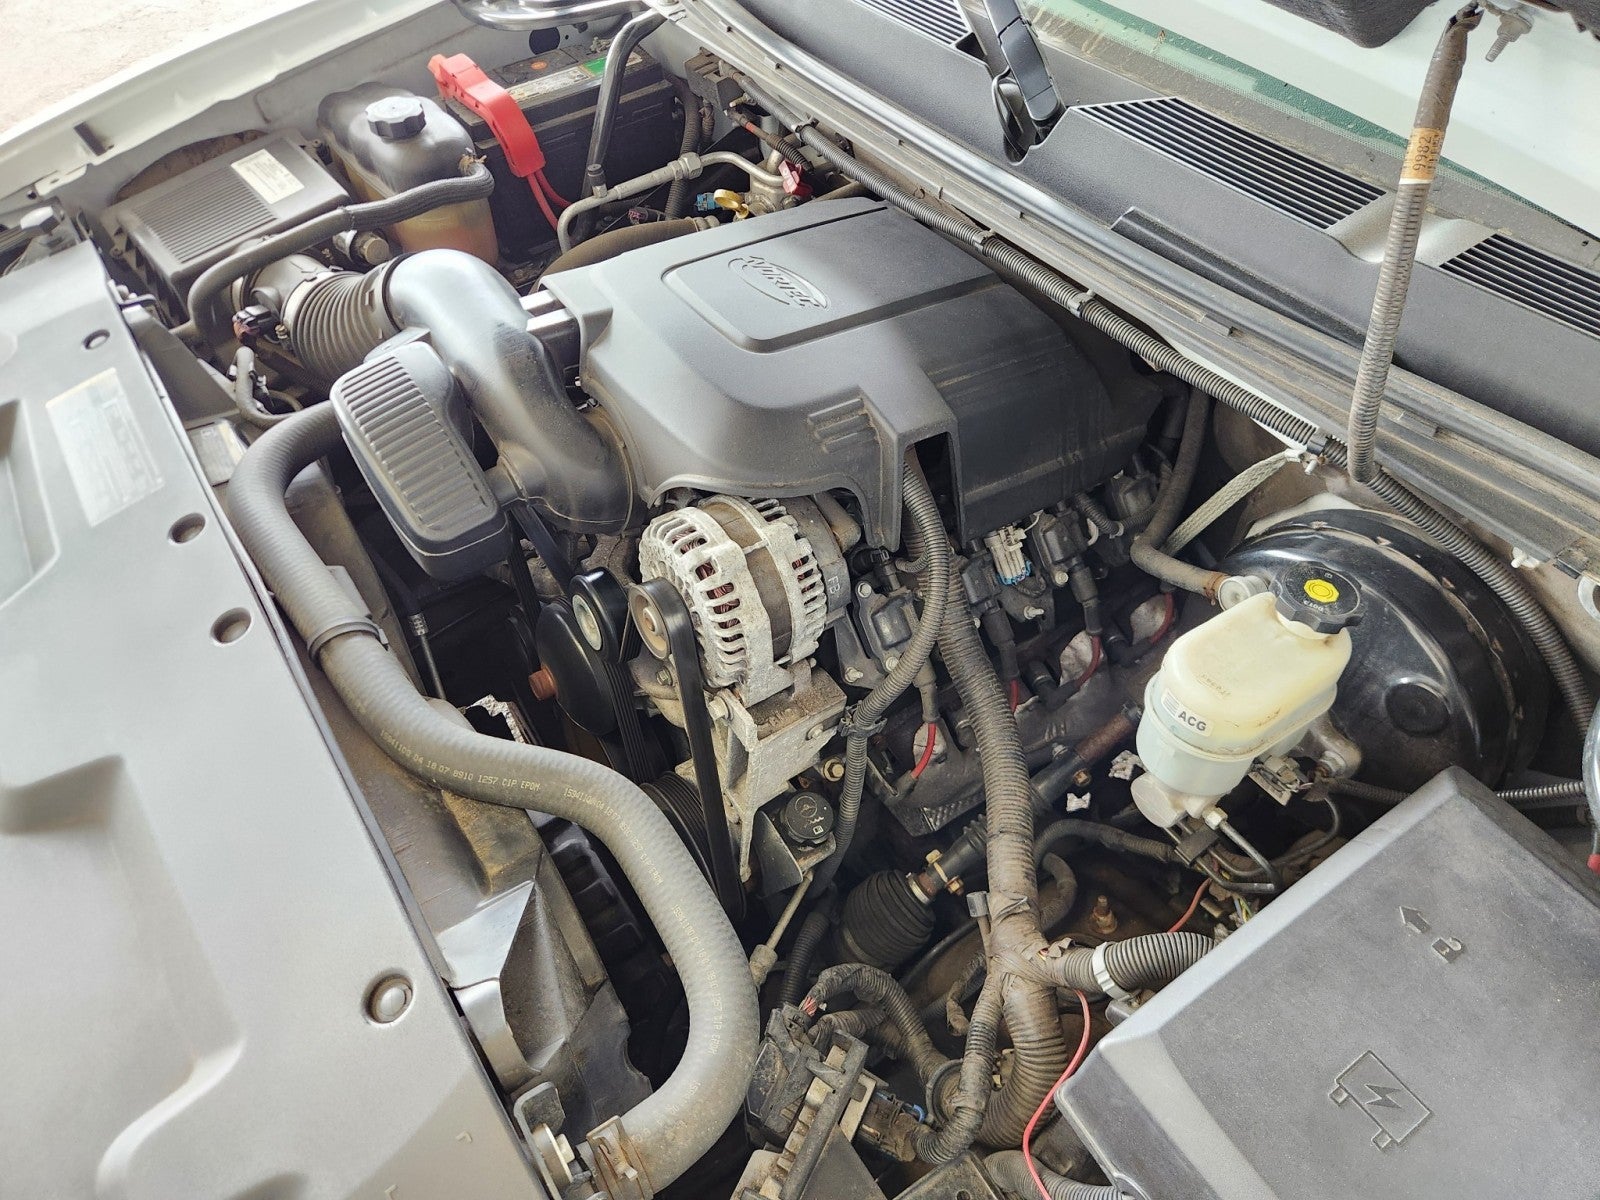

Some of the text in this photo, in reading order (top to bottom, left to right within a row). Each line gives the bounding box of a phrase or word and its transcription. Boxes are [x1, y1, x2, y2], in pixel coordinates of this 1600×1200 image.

[1412, 137, 1431, 170] 9982
[1178, 711, 1207, 731] ACG
[439, 765, 450, 774] 07
[478, 774, 499, 785] 1257
